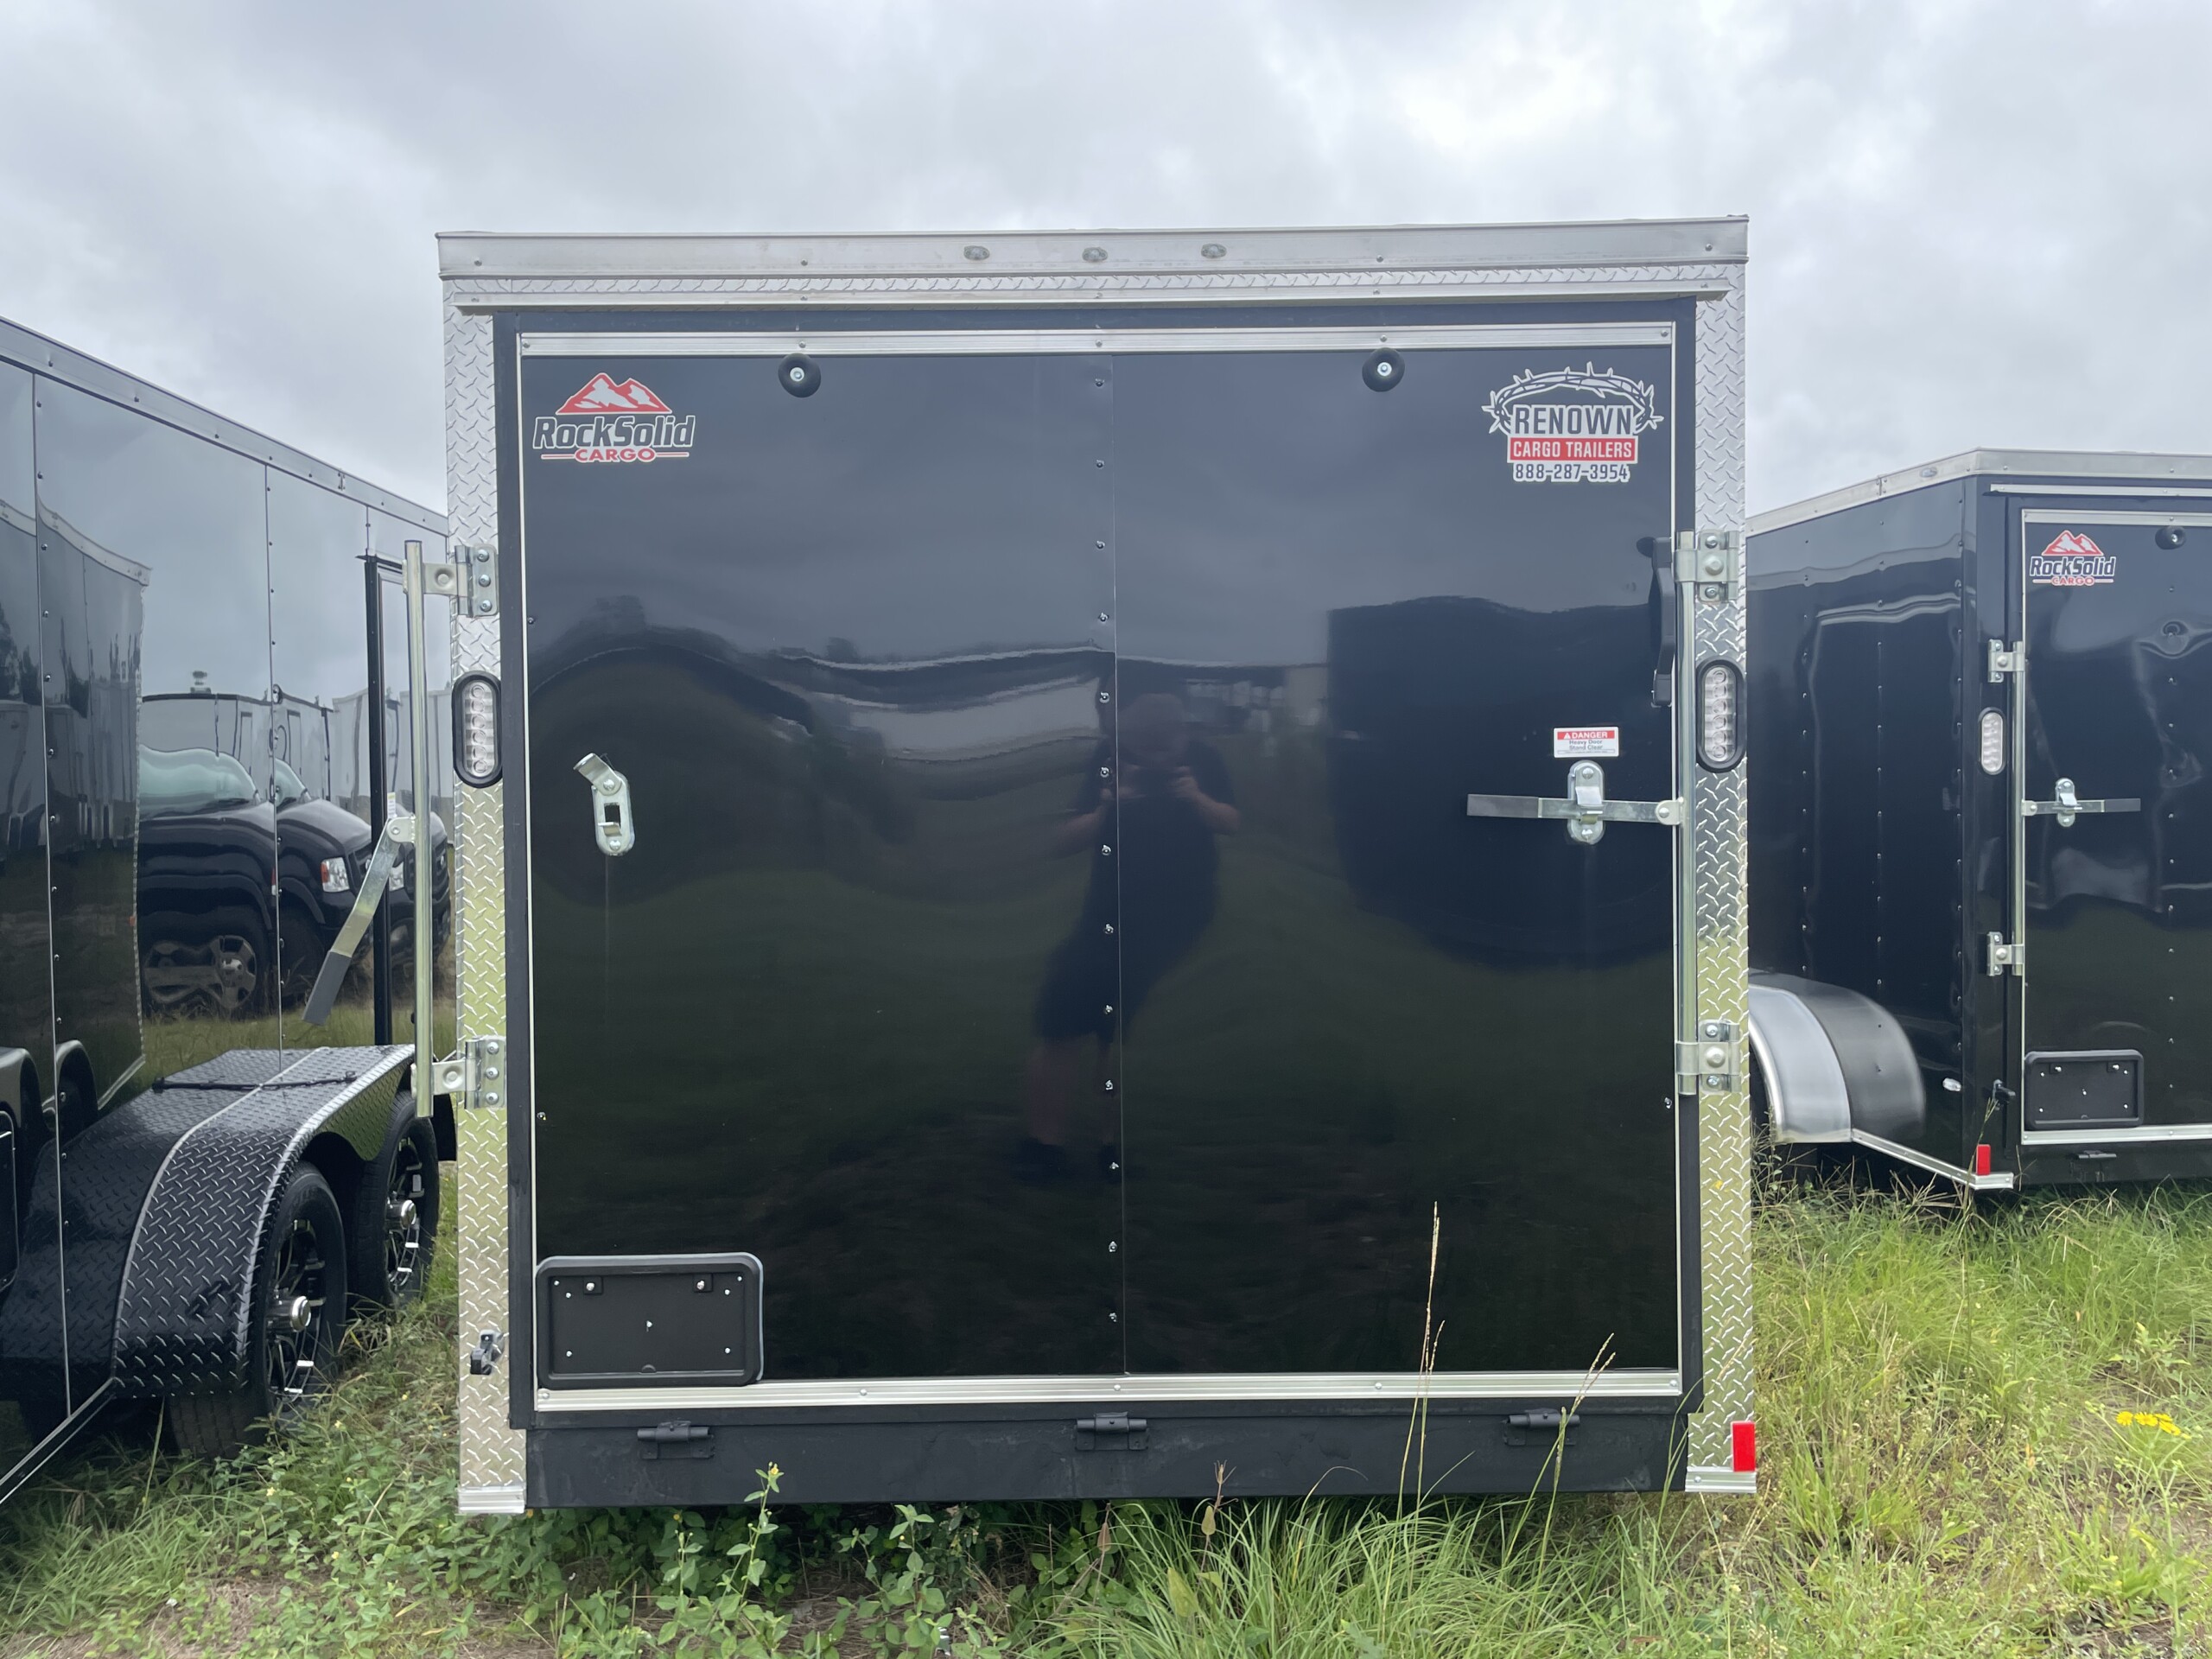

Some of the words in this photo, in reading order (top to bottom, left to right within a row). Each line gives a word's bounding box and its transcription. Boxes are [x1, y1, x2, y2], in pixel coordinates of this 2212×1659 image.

[1514, 406, 1631, 435] RENOWN
[533, 416, 695, 448] RockSolid
[575, 448, 655, 461] CARGO
[1514, 442, 1560, 457] CARGO
[1566, 442, 1632, 457] TRAILERS
[1516, 463, 1628, 480] 888-287-3954
[2030, 556, 2116, 576] RockSolid
